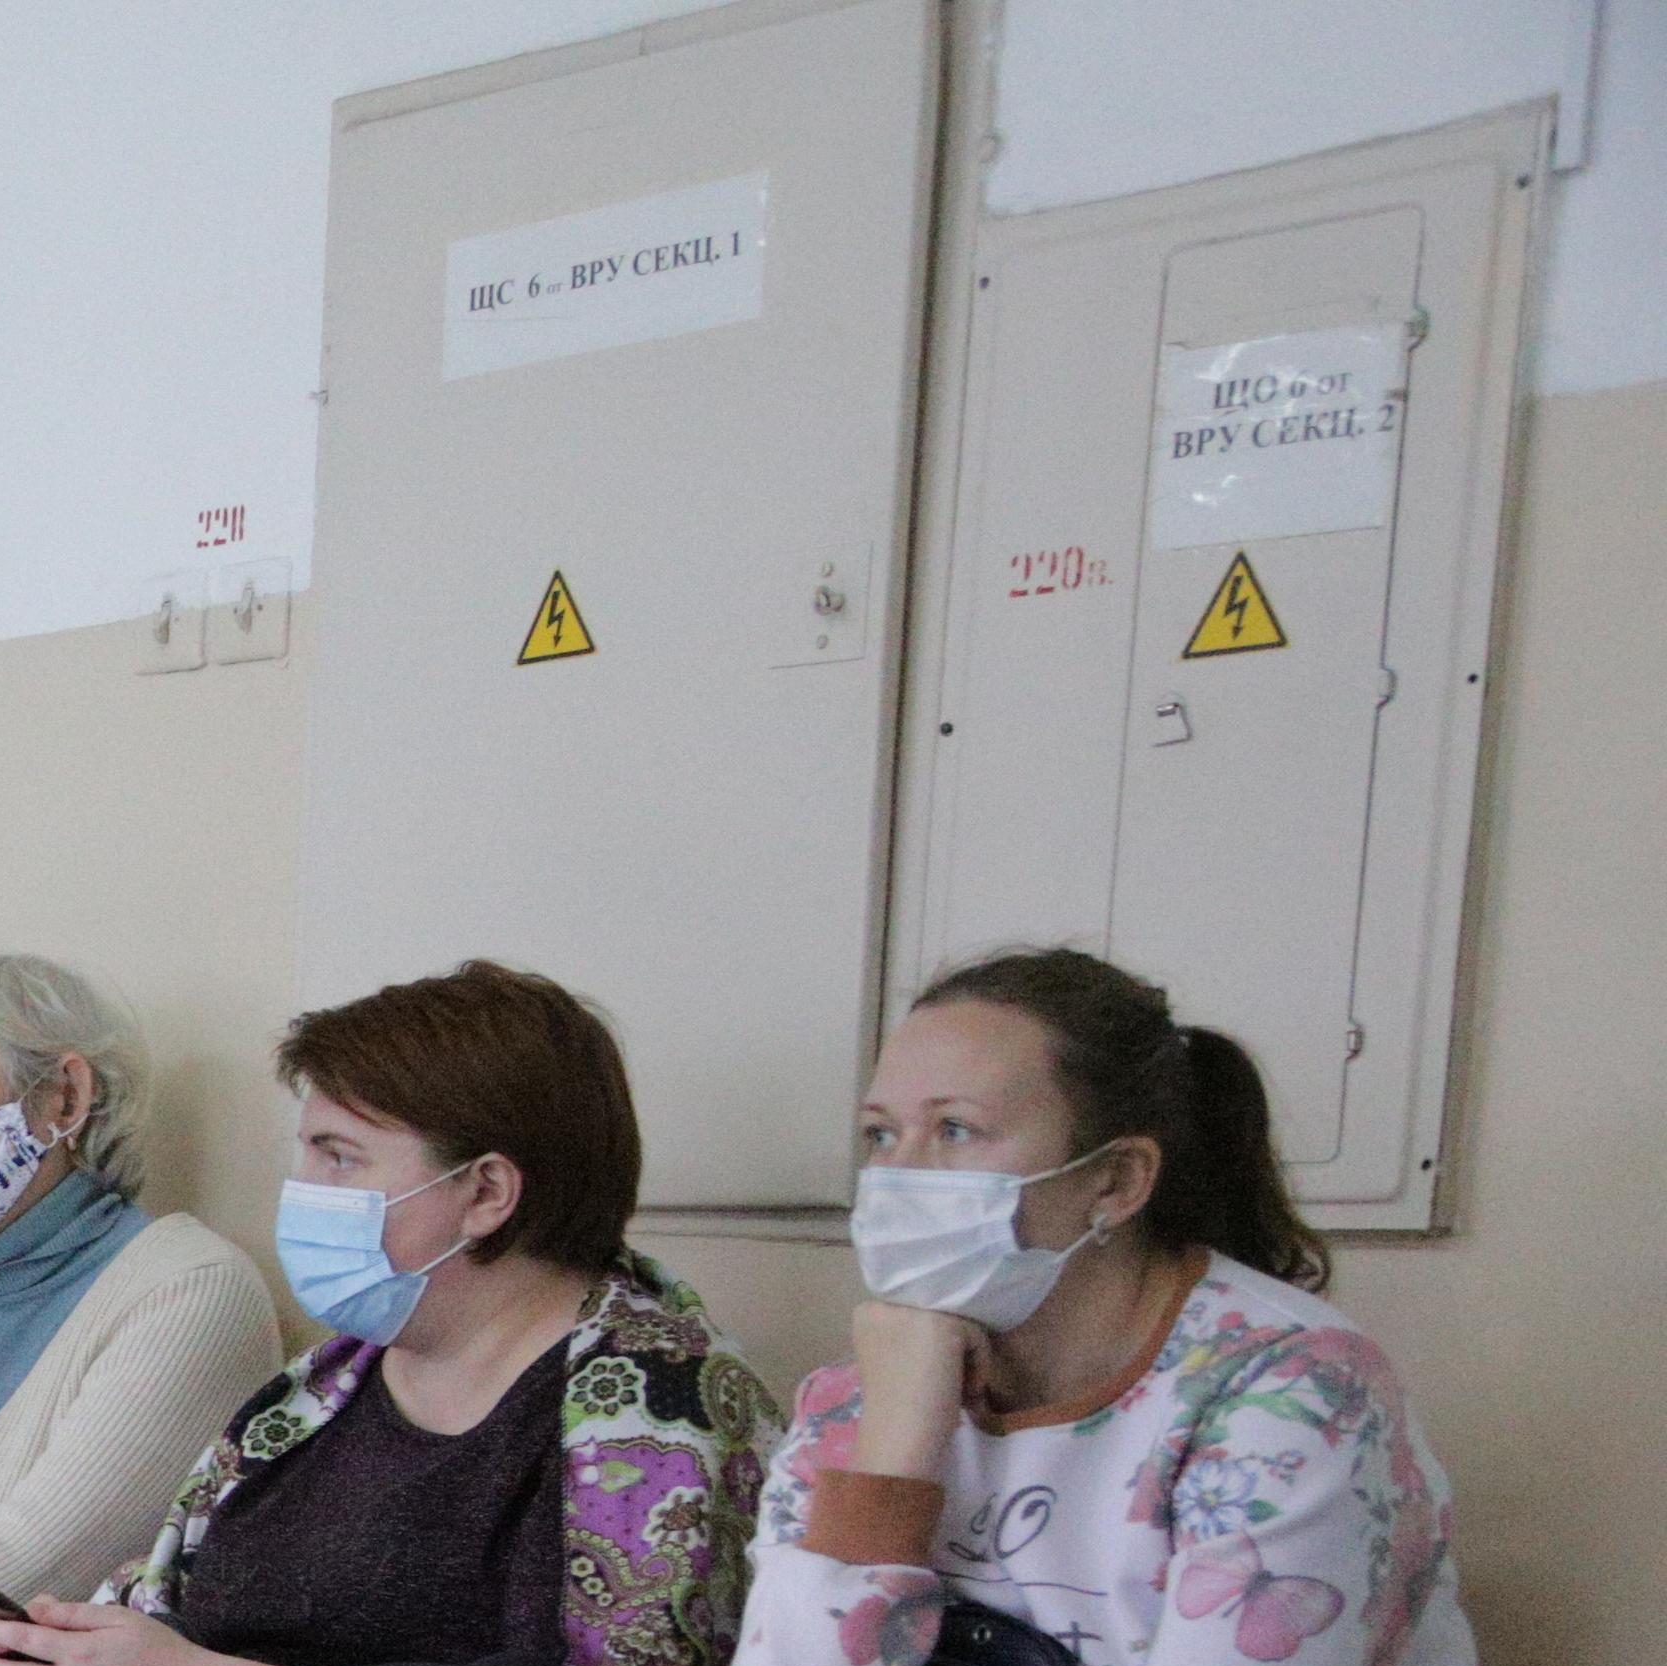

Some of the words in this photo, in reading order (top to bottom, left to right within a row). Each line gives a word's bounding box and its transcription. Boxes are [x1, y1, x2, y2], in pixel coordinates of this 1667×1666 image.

[469, 279, 515, 312] ЩС
[528, 272, 541, 299] 6
[547, 282, 563, 296] от
[570, 255, 625, 290] ВРУ
[632, 235, 721, 277] СЕКЦ.
[731, 230, 742, 257] 1
[1213, 374, 1279, 410] ЩО
[1317, 372, 1354, 395] от
[1171, 422, 1243, 460] ВРУ
[1252, 407, 1365, 449] СЕКЦ.
[1377, 404, 1397, 433] 2
